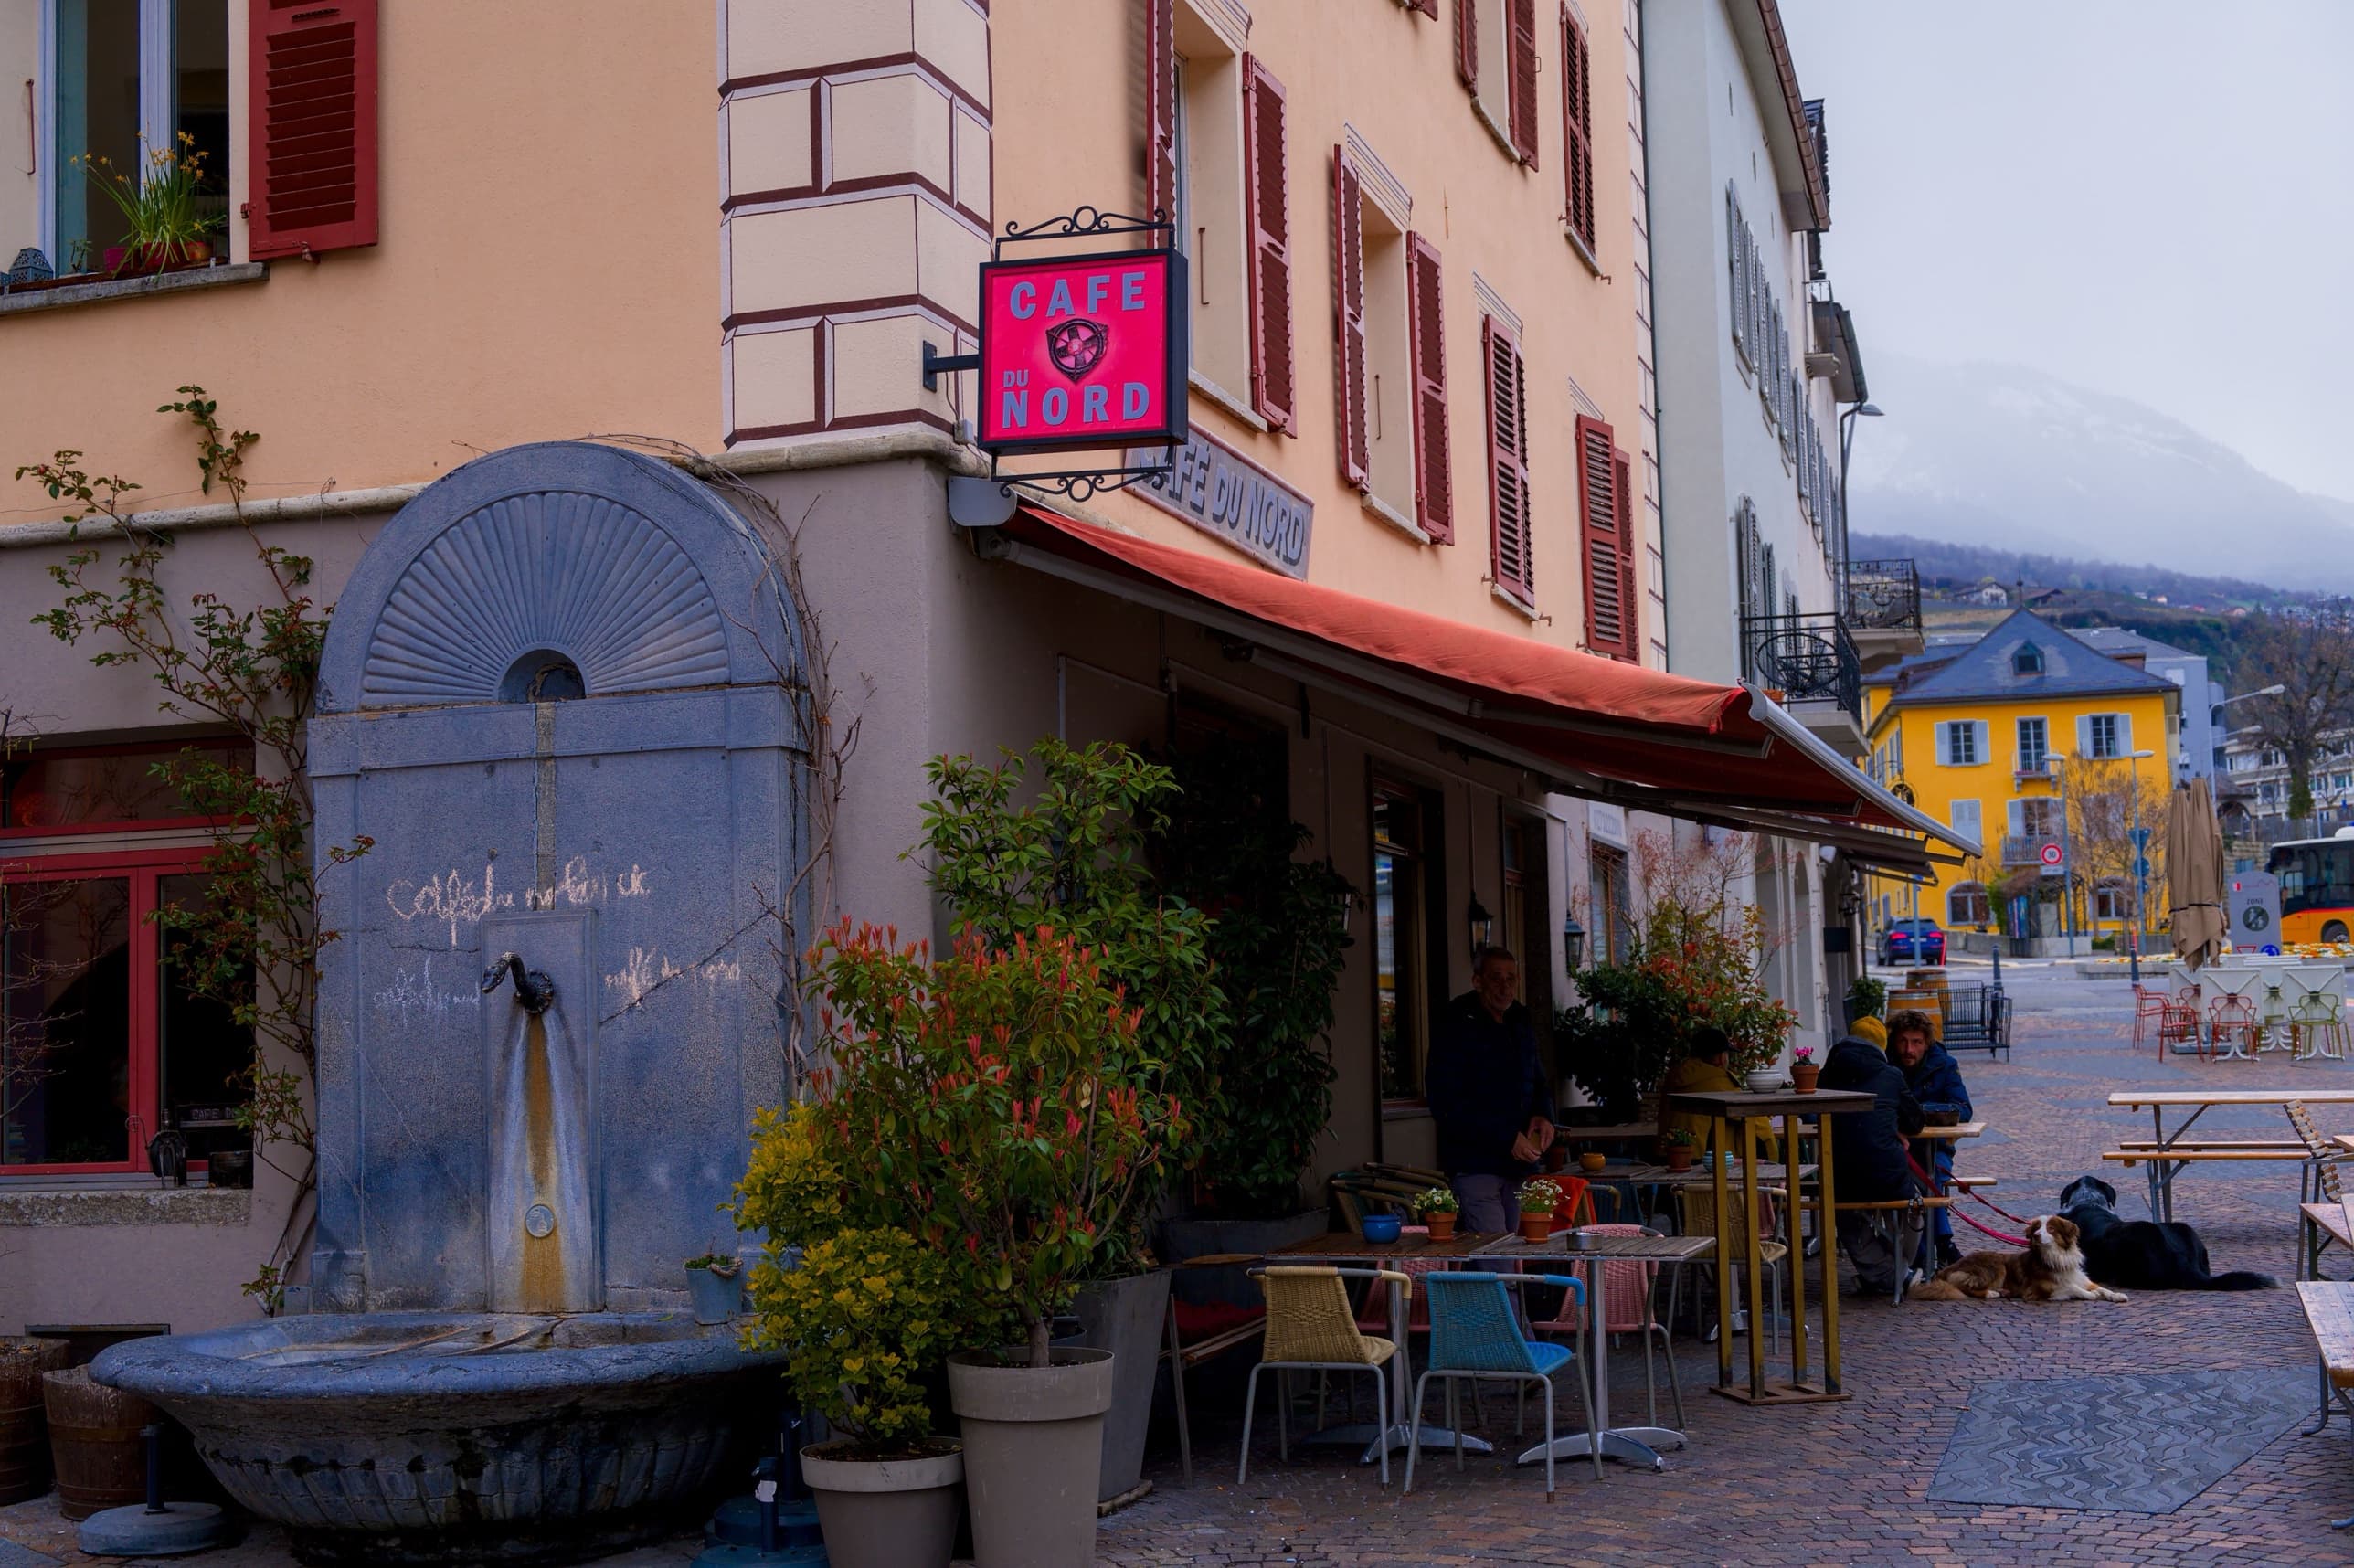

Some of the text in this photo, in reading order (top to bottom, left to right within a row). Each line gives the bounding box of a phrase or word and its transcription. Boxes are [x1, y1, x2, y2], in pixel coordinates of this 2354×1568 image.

[1010, 271, 1146, 320] CAFE
[1002, 369, 1029, 388] DU
[1002, 381, 1150, 429] NORD
[1212, 463, 1244, 531] DU
[1246, 477, 1306, 567] NORD
